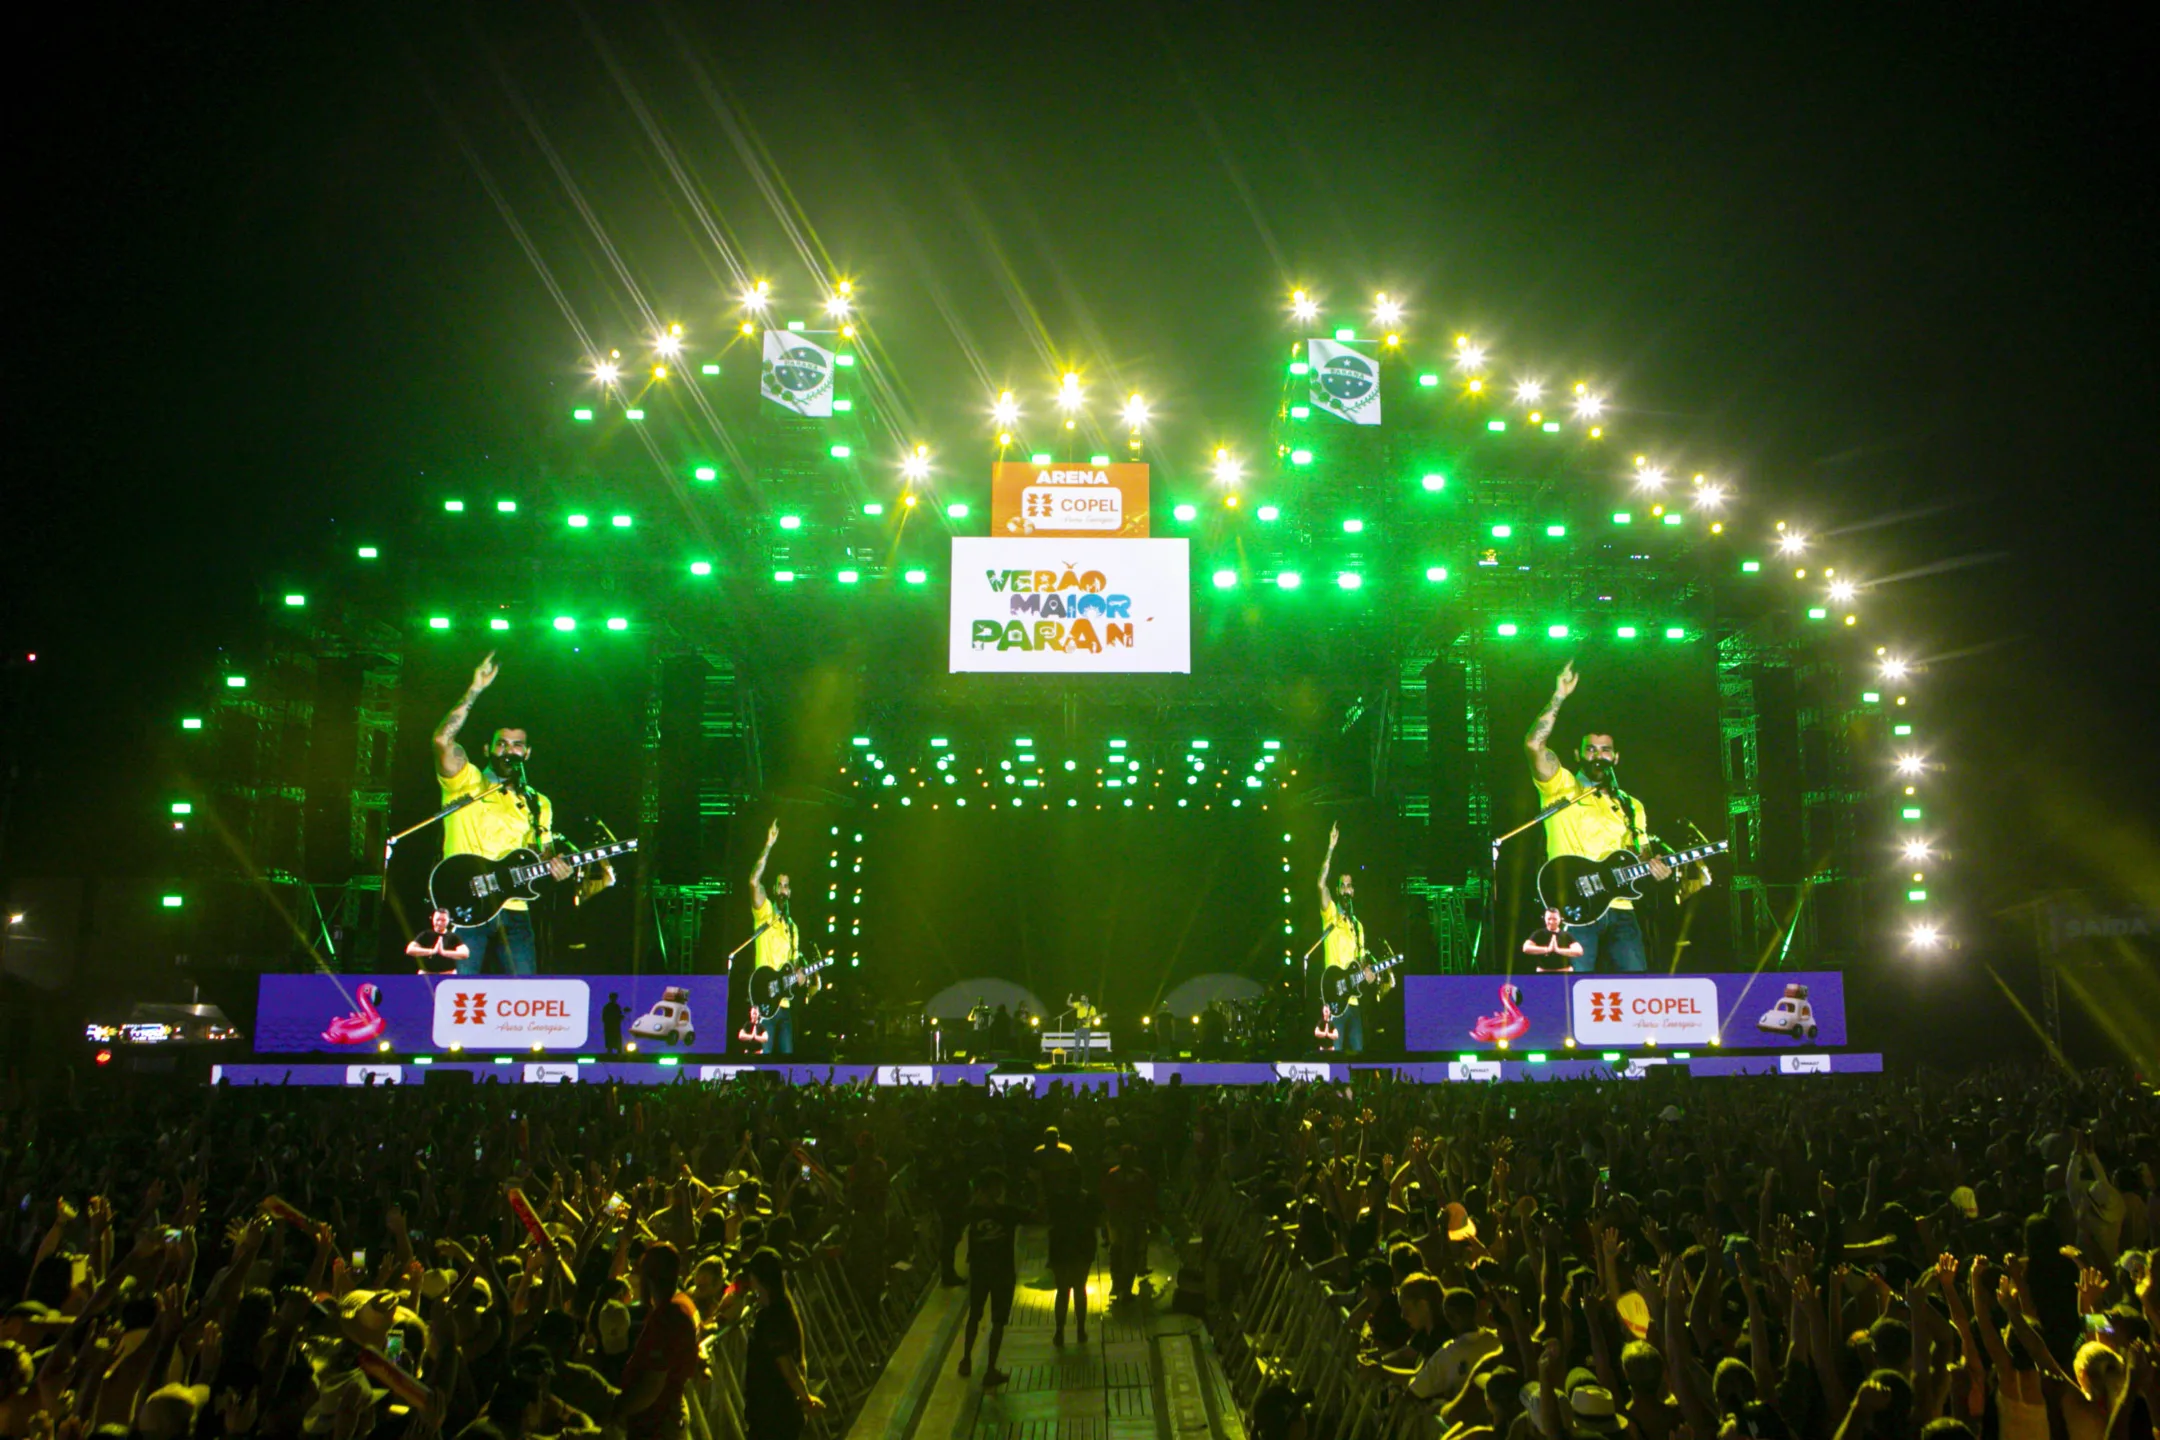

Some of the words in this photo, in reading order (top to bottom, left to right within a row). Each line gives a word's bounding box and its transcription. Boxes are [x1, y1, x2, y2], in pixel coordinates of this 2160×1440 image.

[1036, 470, 1109, 484] ARENA
[1061, 498, 1118, 512] COPEL
[985, 560, 1107, 593] VERÃO
[1010, 593, 1132, 619] MAIOR
[497, 1000, 571, 1017] COPEL
[1632, 997, 1701, 1014] COPEL
